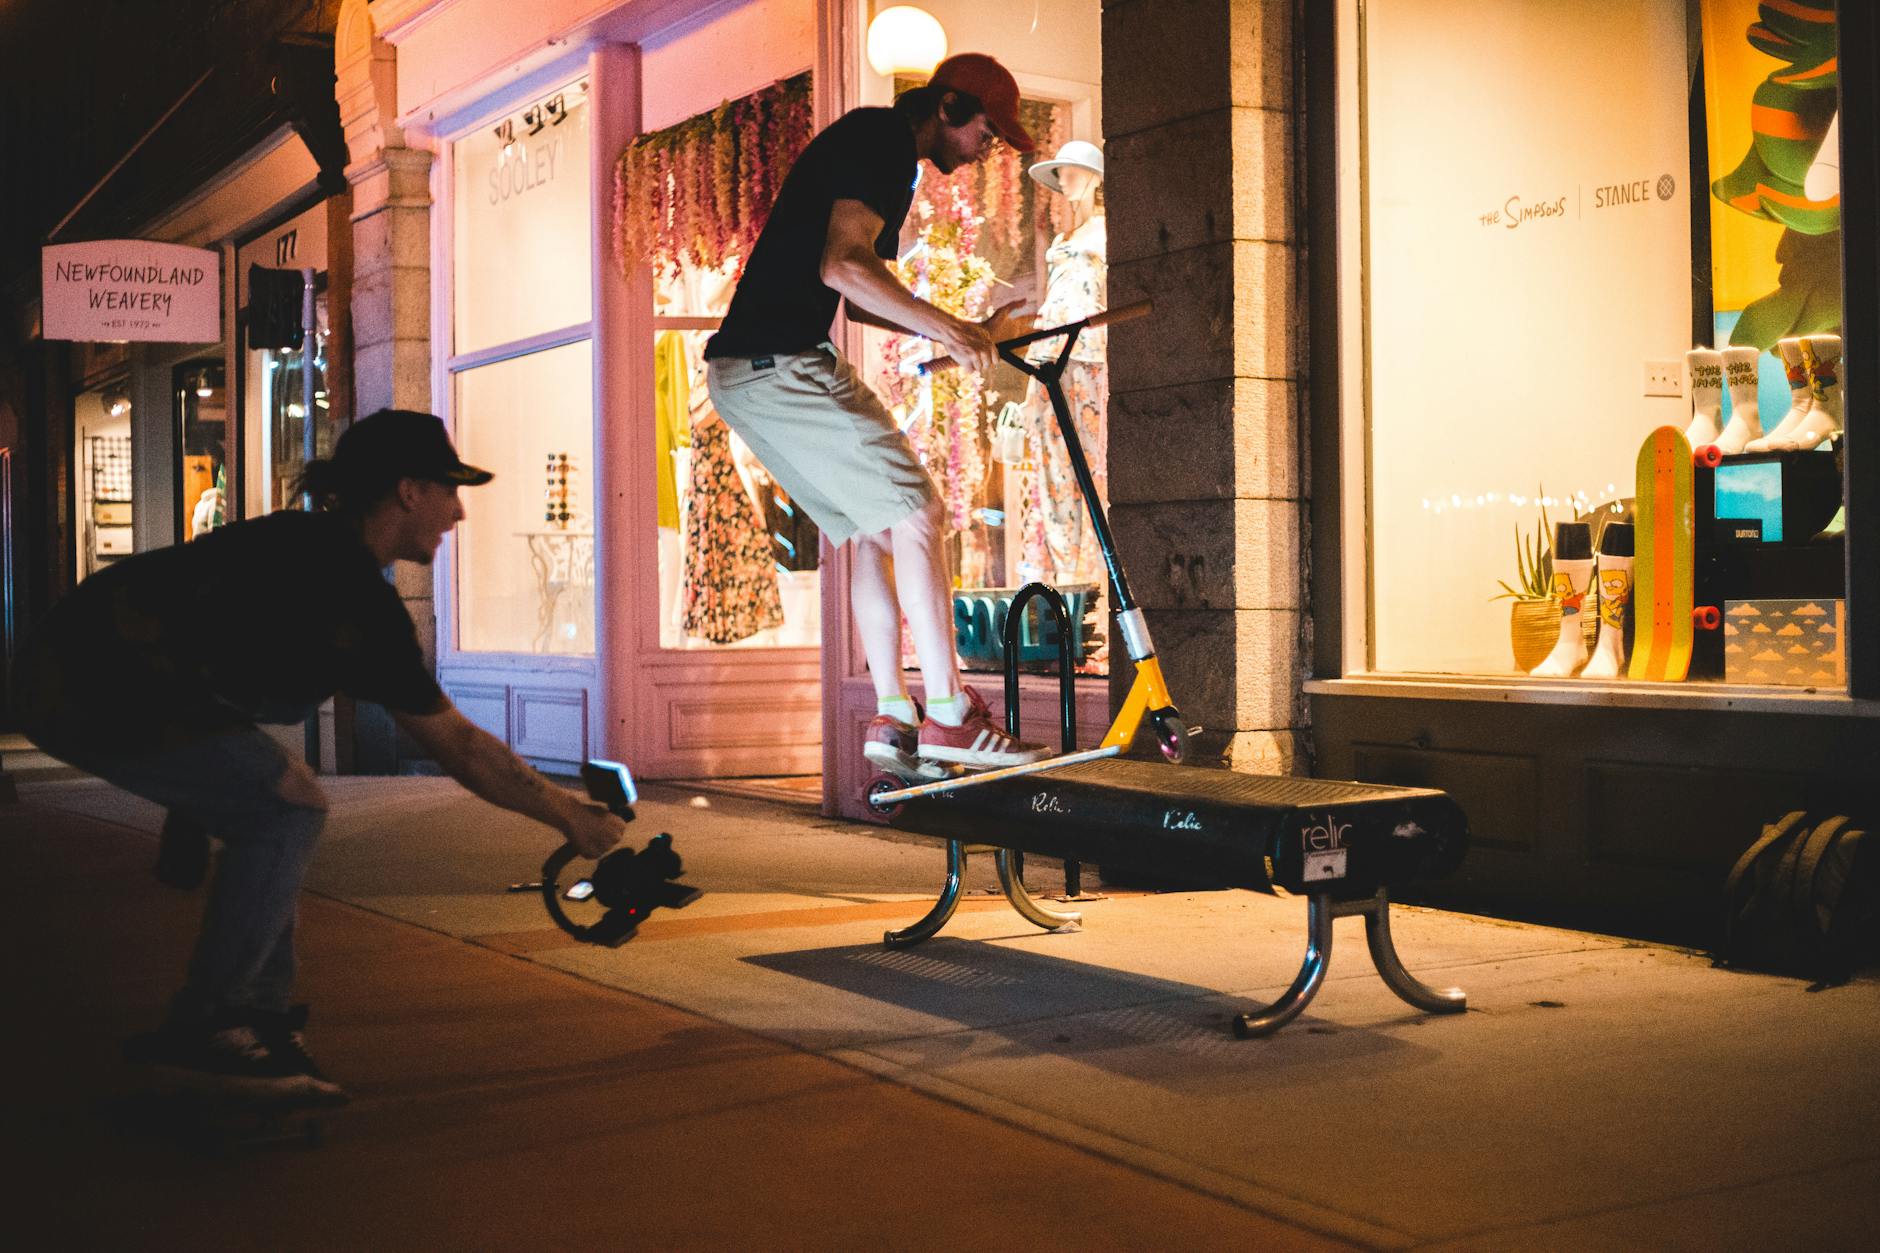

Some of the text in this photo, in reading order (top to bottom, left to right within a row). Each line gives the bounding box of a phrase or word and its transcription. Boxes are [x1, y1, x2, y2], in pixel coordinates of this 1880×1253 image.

[489, 140, 558, 206] SOOLEY
[1595, 180, 1650, 208] STANCE
[276, 229, 297, 267] 177
[56, 261, 204, 286] NEWFOUNDLAND
[89, 287, 172, 316] WEAVERY
[1301, 814, 1353, 850] relic
